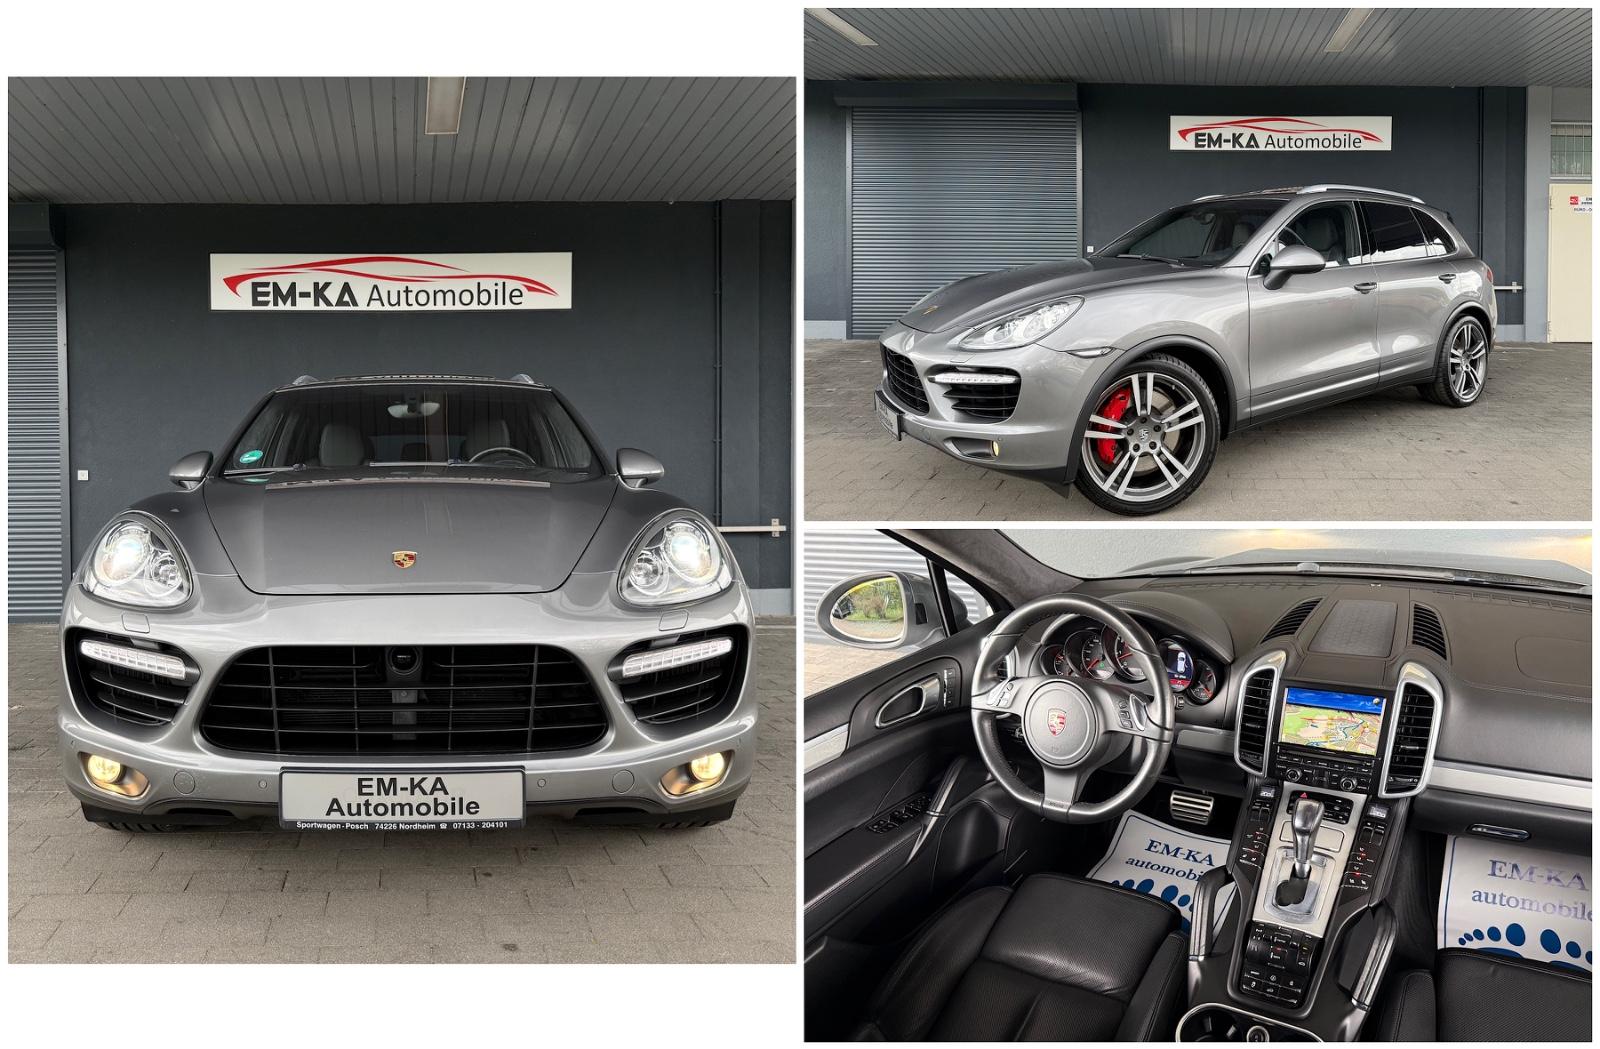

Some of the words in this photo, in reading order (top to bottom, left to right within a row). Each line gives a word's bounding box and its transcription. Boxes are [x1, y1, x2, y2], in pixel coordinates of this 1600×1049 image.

[1194, 132, 1260, 149] EM-KA
[1264, 133, 1362, 149] Automobile
[250, 281, 359, 308] EM-KA
[366, 282, 524, 308] Automobile
[357, 777, 449, 796] EM-KA
[325, 797, 480, 816] Automobile
[296, 821, 341, 830] Sportwagen
[345, 822, 369, 830] Posch
[399, 822, 436, 830] Nordheim
[452, 822, 476, 830] 07133
[481, 821, 508, 829] 204101
[1144, 838, 1215, 867] EM-KA
[1125, 857, 1204, 882] automobi
[1487, 859, 1590, 892] EM-KA
